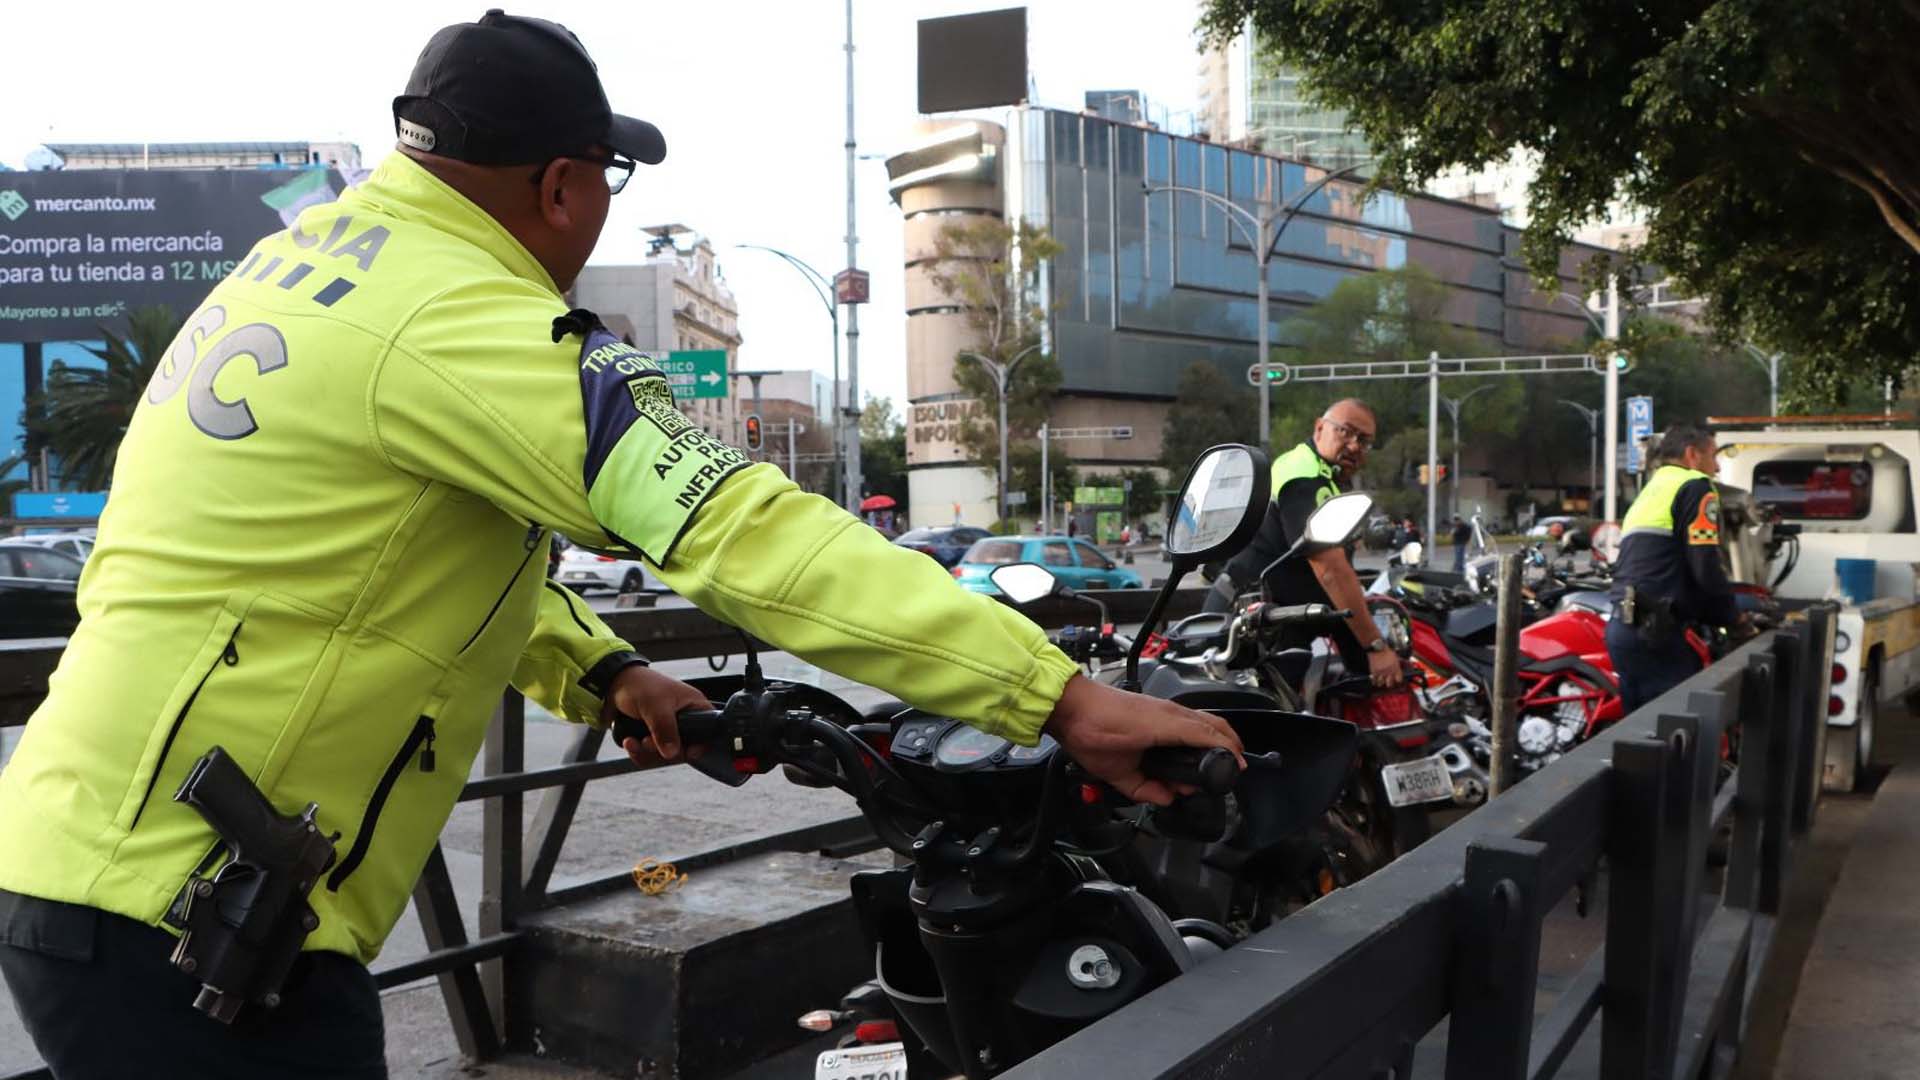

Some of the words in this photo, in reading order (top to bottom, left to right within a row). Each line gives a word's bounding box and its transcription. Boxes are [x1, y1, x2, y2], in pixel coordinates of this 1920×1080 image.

[35, 197, 157, 212] mercanto.mx
[0, 234, 81, 258] Compra
[87, 233, 105, 252] la
[111, 230, 223, 252] mercancía
[0, 266, 44, 287] para
[50, 263, 72, 283] tu
[78, 262, 145, 282] tienda
[151, 265, 165, 281] a
[171, 261, 195, 280] 12
[201, 260, 240, 280] MS
[0, 306, 57, 321] Mayoreo
[61, 308, 70, 318] a
[73, 306, 91, 318] un
